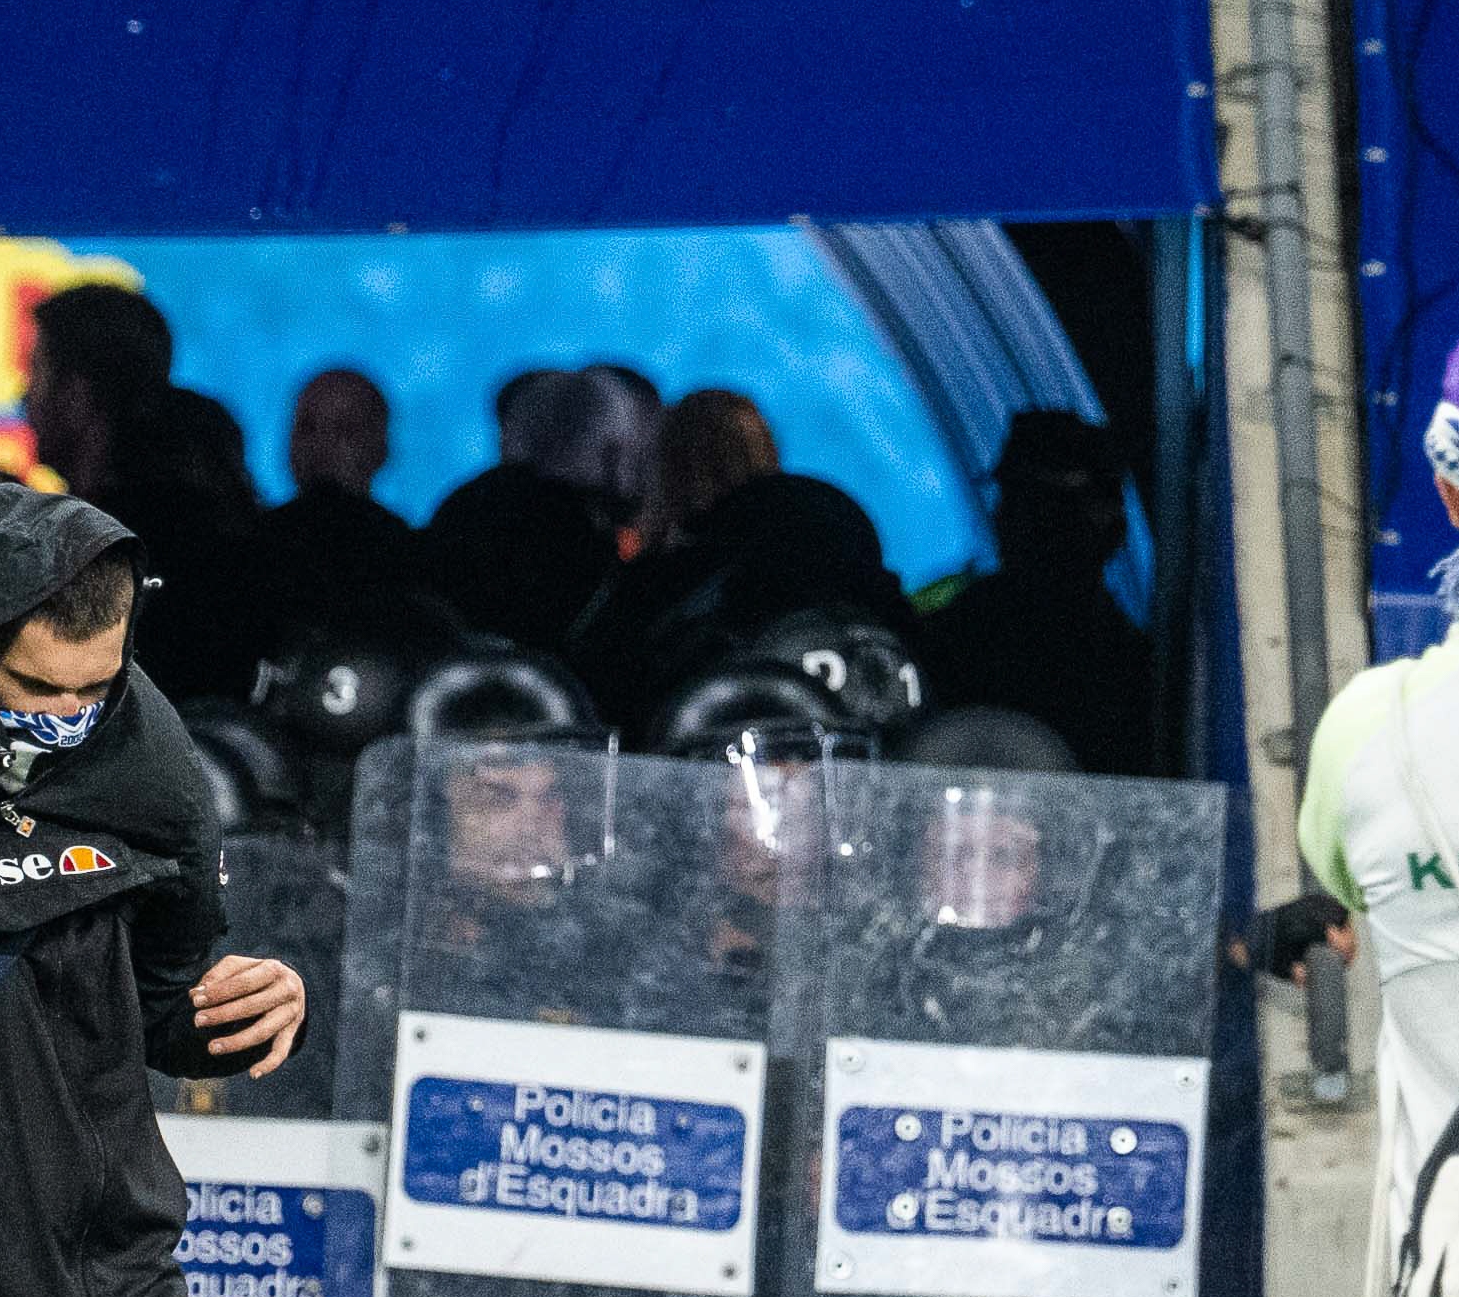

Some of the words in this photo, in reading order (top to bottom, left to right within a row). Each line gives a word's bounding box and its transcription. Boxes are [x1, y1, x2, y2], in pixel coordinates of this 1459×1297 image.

[322, 665, 359, 715] 3
[513, 1082, 658, 1136] Policia
[940, 1111, 1088, 1156] Policia
[499, 1122, 667, 1177] Mossos
[924, 1146, 1099, 1196] Mossos
[458, 1162, 699, 1221] d'Esquadra
